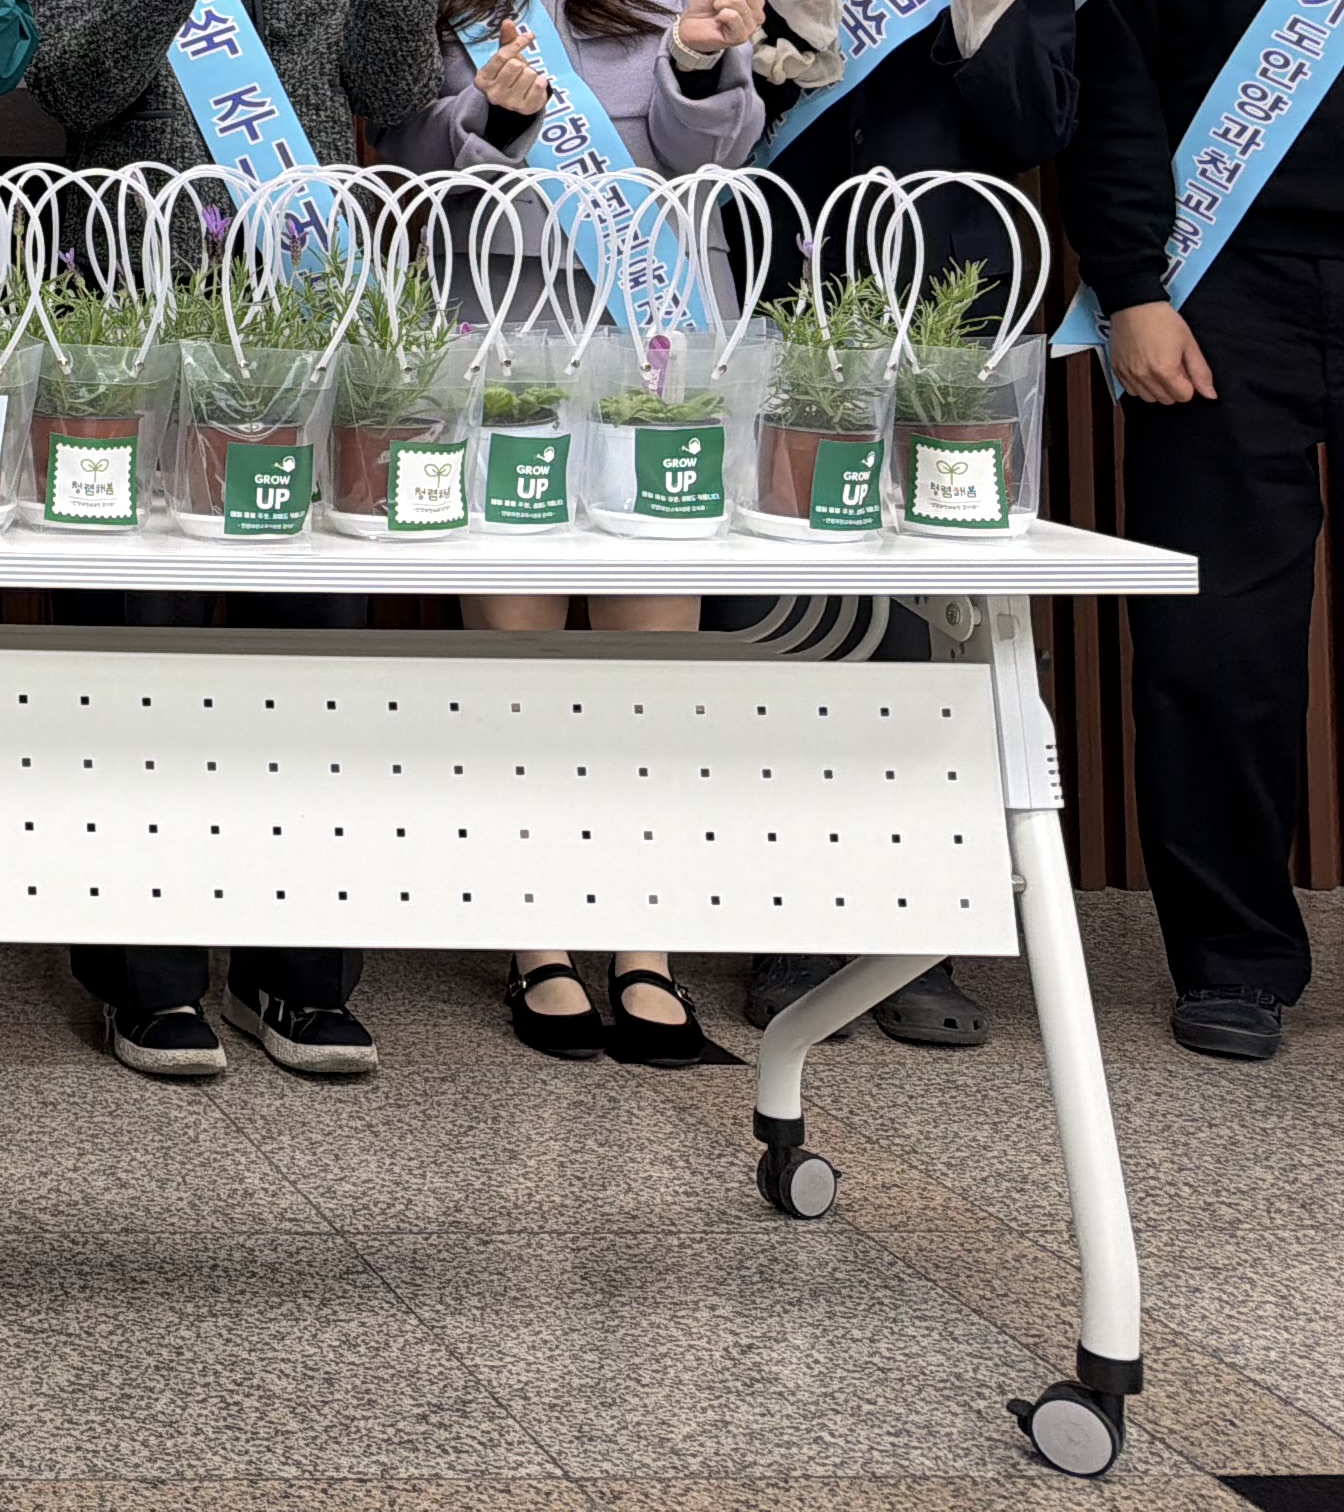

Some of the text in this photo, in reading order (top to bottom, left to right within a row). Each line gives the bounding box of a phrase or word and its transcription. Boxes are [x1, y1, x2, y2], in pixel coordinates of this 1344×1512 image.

[517, 465, 550, 475] GROW
[663, 458, 697, 468] GROW
[255, 474, 290, 485] GROW
[665, 471, 696, 492] UP
[843, 471, 871, 481] GROW
[517, 478, 549, 499] UP
[842, 485, 868, 505] UP
[256, 488, 290, 509] UP
